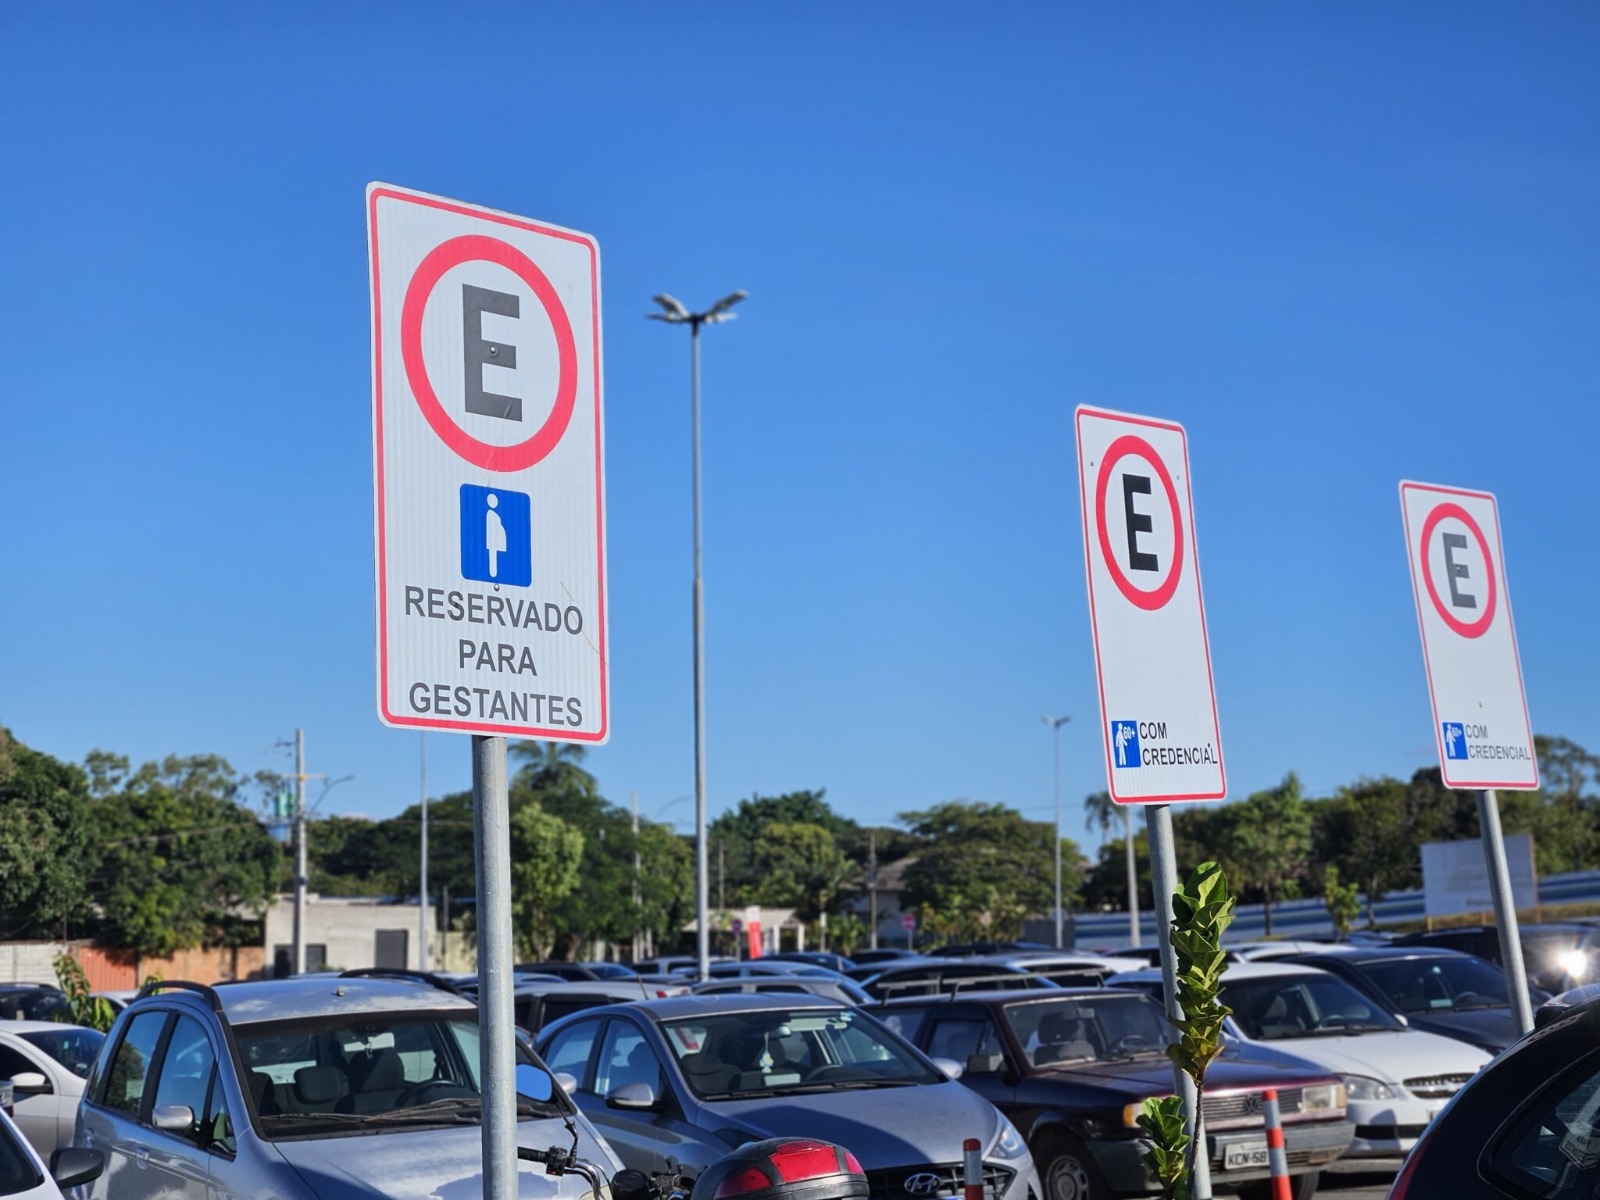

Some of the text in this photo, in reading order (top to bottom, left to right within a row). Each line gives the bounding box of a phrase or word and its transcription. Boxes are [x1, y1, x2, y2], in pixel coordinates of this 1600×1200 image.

[462, 283, 523, 422] E
[1122, 473, 1159, 572] E
[1442, 532, 1477, 609] E
[405, 585, 583, 635] RESERVADO
[459, 638, 538, 676] PARA
[409, 682, 583, 727] GESTANTES
[1139, 722, 1168, 740] COM
[1465, 724, 1489, 739] COM
[1142, 747, 1218, 766] CREDENCIAL
[1468, 745, 1531, 760] CREDENCIAL
